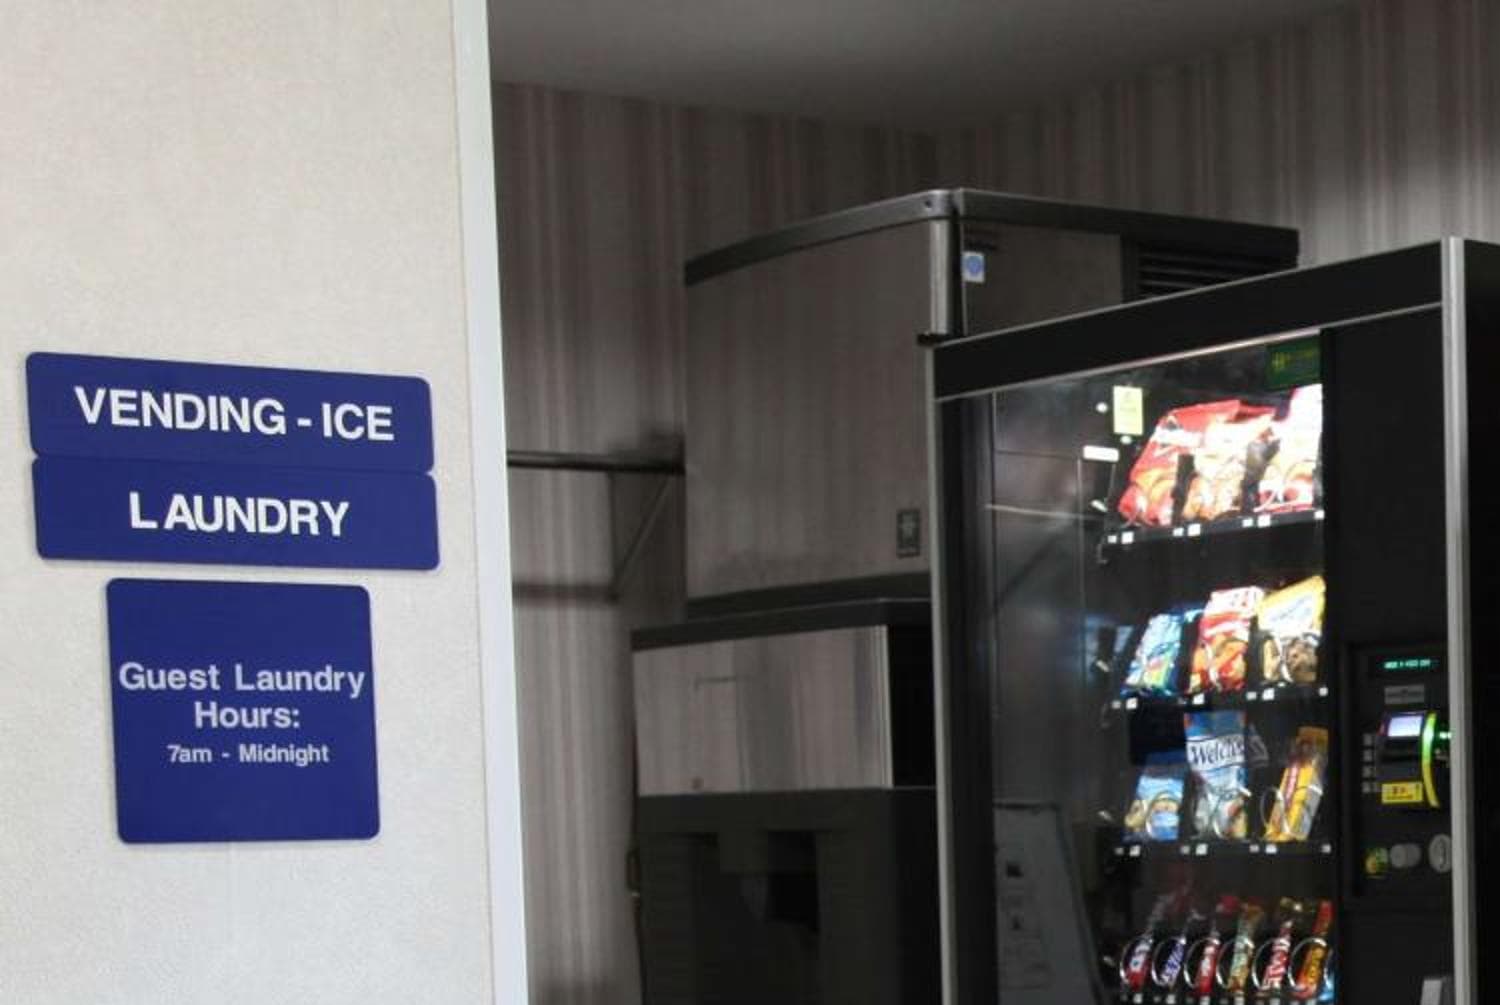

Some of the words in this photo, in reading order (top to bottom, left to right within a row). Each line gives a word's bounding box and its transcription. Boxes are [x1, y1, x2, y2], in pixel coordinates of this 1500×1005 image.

[75, 387, 286, 434] VENDING
[322, 403, 394, 441] ICE
[129, 492, 349, 536] LAUNDRY
[119, 662, 220, 691] Guest
[235, 664, 365, 698] Laundry
[195, 702, 299, 730] Hours:
[167, 745, 212, 764] 7am
[239, 744, 330, 767] Midnight
